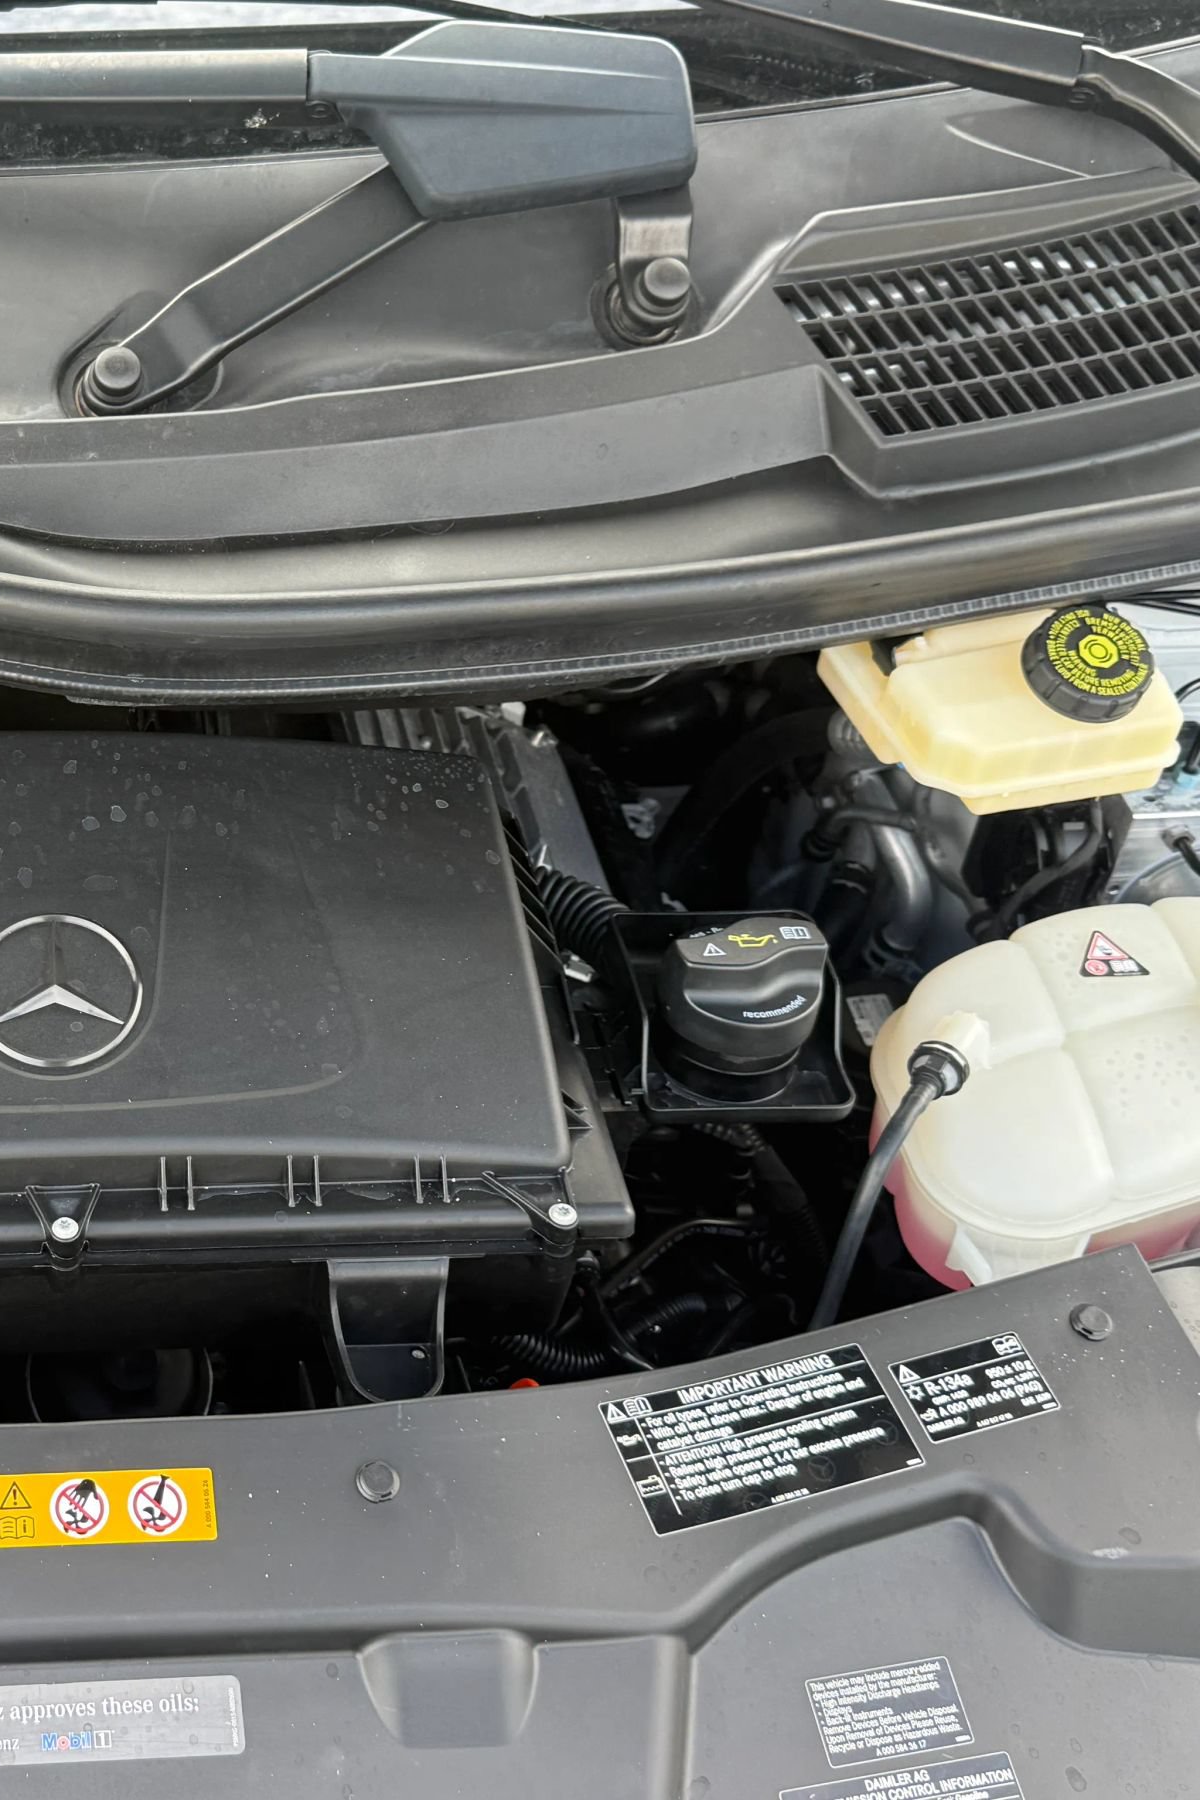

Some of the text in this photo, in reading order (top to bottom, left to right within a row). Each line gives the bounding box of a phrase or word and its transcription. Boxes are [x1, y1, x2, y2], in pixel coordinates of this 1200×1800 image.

[1103, 614, 1146, 651] NUR ORIGINAL
[1055, 661, 1072, 679] FLUID
[1068, 676, 1091, 692] FROM
[1097, 685, 1126, 696] SEALED
[1060, 657, 1074, 671] CAP
[1069, 668, 1099, 686] BEFORE
[743, 995, 807, 1018] recommended
[678, 1354, 834, 1404] IMPORTANT WARNING
[924, 1374, 974, 1395] R-134a
[986, 1366, 1005, 1378] 950
[1012, 1361, 1024, 1371] 10
[646, 1417, 663, 1427] For
[664, 1413, 677, 1423] oil
[706, 1402, 728, 1413] refer
[728, 1399, 741, 1408] to
[740, 1387, 789, 1405] Operating
[786, 1373, 843, 1392] Instructions
[651, 1427, 675, 1439] With
[675, 1423, 688, 1434] oil
[687, 1418, 711, 1431] level
[710, 1412, 740, 1425] above
[766, 1395, 802, 1411] Danger
[802, 1391, 813, 1401] of
[813, 1384, 846, 1398] engine
[845, 1378, 865, 1390] and
[939, 1381, 1043, 1417] A 000 989 06 06 (PAG)
[657, 1426, 733, 1450] catalyst damage
[665, 1410, 856, 1465] ATTENTION! High pressure cooling system
[669, 1438, 799, 1478] Relieve high pressure slowly
[675, 1428, 884, 1491] Safety valve opens at 1.4 bar excess pressure
[680, 1464, 797, 1500] To close turn cap to stop
[810, 1683, 825, 1691] This
[825, 1678, 849, 1689] vehicle
[865, 1671, 890, 1682] include
[890, 1662, 940, 1677] mercury-added
[813, 1690, 839, 1700] devices
[839, 1683, 868, 1696] installed
[890, 1673, 937, 1686] manufacturer:
[10, 1701, 95, 1723] approves
[102, 1697, 153, 1715] these
[159, 1694, 199, 1712] oils:
[821, 1682, 940, 1709] High Intensity Discharge Headlamps
[823, 1706, 852, 1718] Displays
[823, 1725, 851, 1735] Remove
[852, 1720, 878, 1730] Devices
[879, 1716, 902, 1725] Before
[902, 1710, 927, 1720] Vehicle
[852, 1707, 893, 1720] Instruments
[41, 1730, 92, 1751] Mobil
[826, 1735, 845, 1746] Upon
[846, 1728, 875, 1740] Removal
[876, 1727, 883, 1735] of
[884, 1723, 911, 1734] Devices
[911, 1719, 934, 1728] Please
[829, 1742, 856, 1753] Recycle
[865, 1736, 892, 1747] Dispose
[902, 1728, 938, 1740] Hazardous
[876, 1748, 882, 1756] A
[882, 1746, 894, 1755] 000
[895, 1744, 908, 1752] 584
[918, 1740, 926, 1748] 17
[864, 1770, 931, 1791] DAIMLER AG
[888, 1783, 939, 1800] CONTROL
[940, 1768, 1014, 1792] INFORMATION
